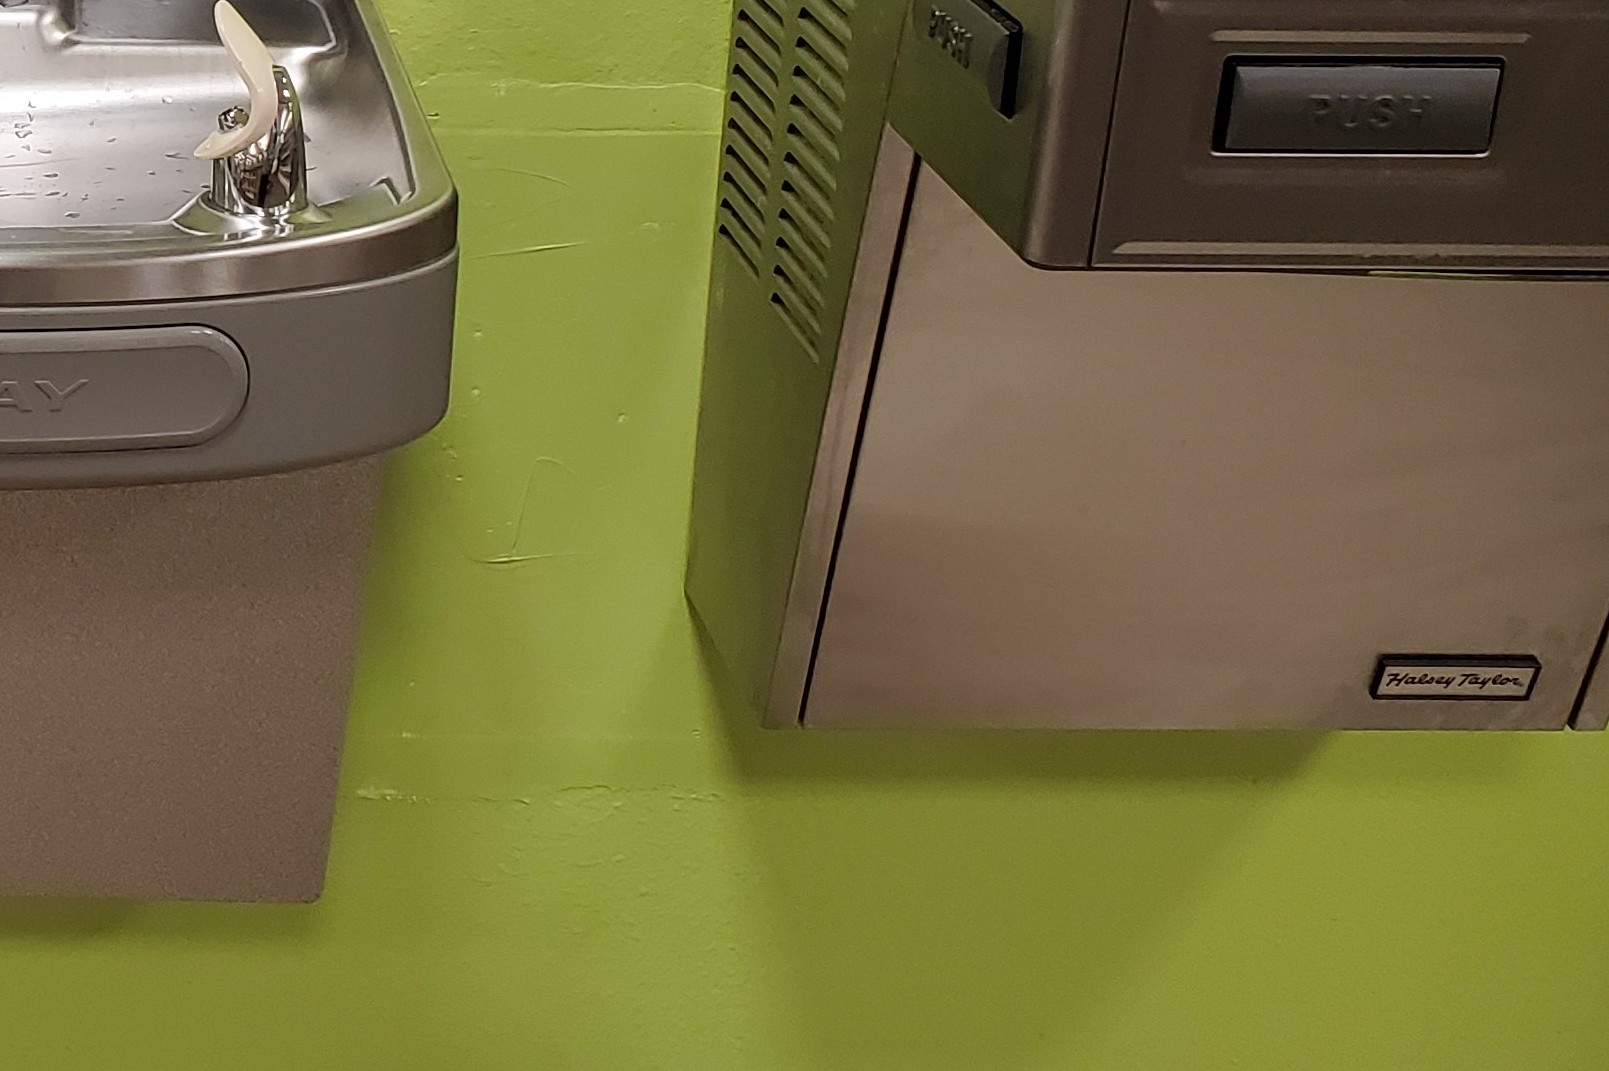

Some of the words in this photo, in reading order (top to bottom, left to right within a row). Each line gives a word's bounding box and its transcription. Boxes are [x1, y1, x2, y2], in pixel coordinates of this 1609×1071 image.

[928, 3, 974, 70] PUSH
[1309, 93, 1433, 130] PUSH
[1386, 672, 1457, 689] Halsey
[1457, 672, 1521, 690] Taylor
